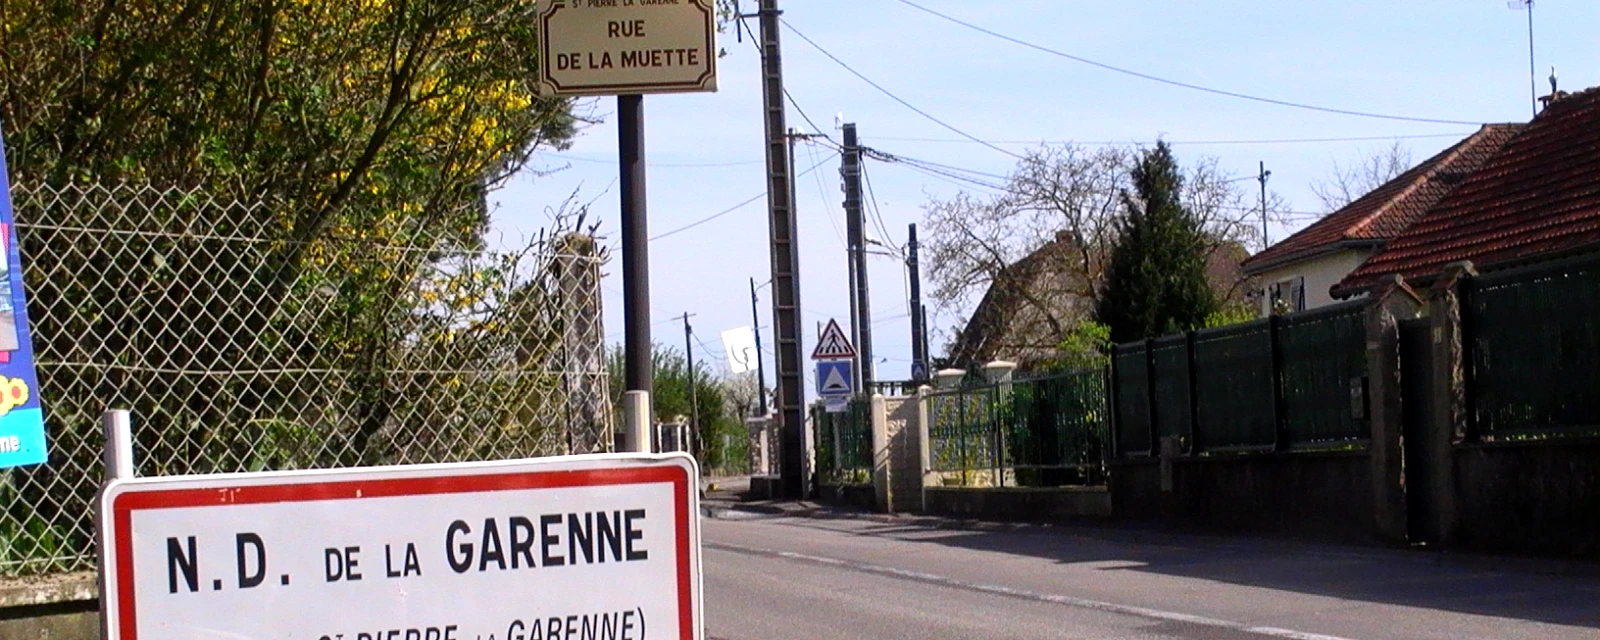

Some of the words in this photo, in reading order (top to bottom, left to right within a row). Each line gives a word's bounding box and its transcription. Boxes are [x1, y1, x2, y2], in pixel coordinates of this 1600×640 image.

[607, 19, 646, 38] RUE
[556, 52, 582, 71] DE
[588, 51, 614, 70] LA
[620, 48, 700, 69] MUETTE
[166, 532, 290, 594] N.D.
[324, 546, 362, 583] DE
[385, 542, 422, 578] LA
[446, 508, 648, 574] GARENNE
